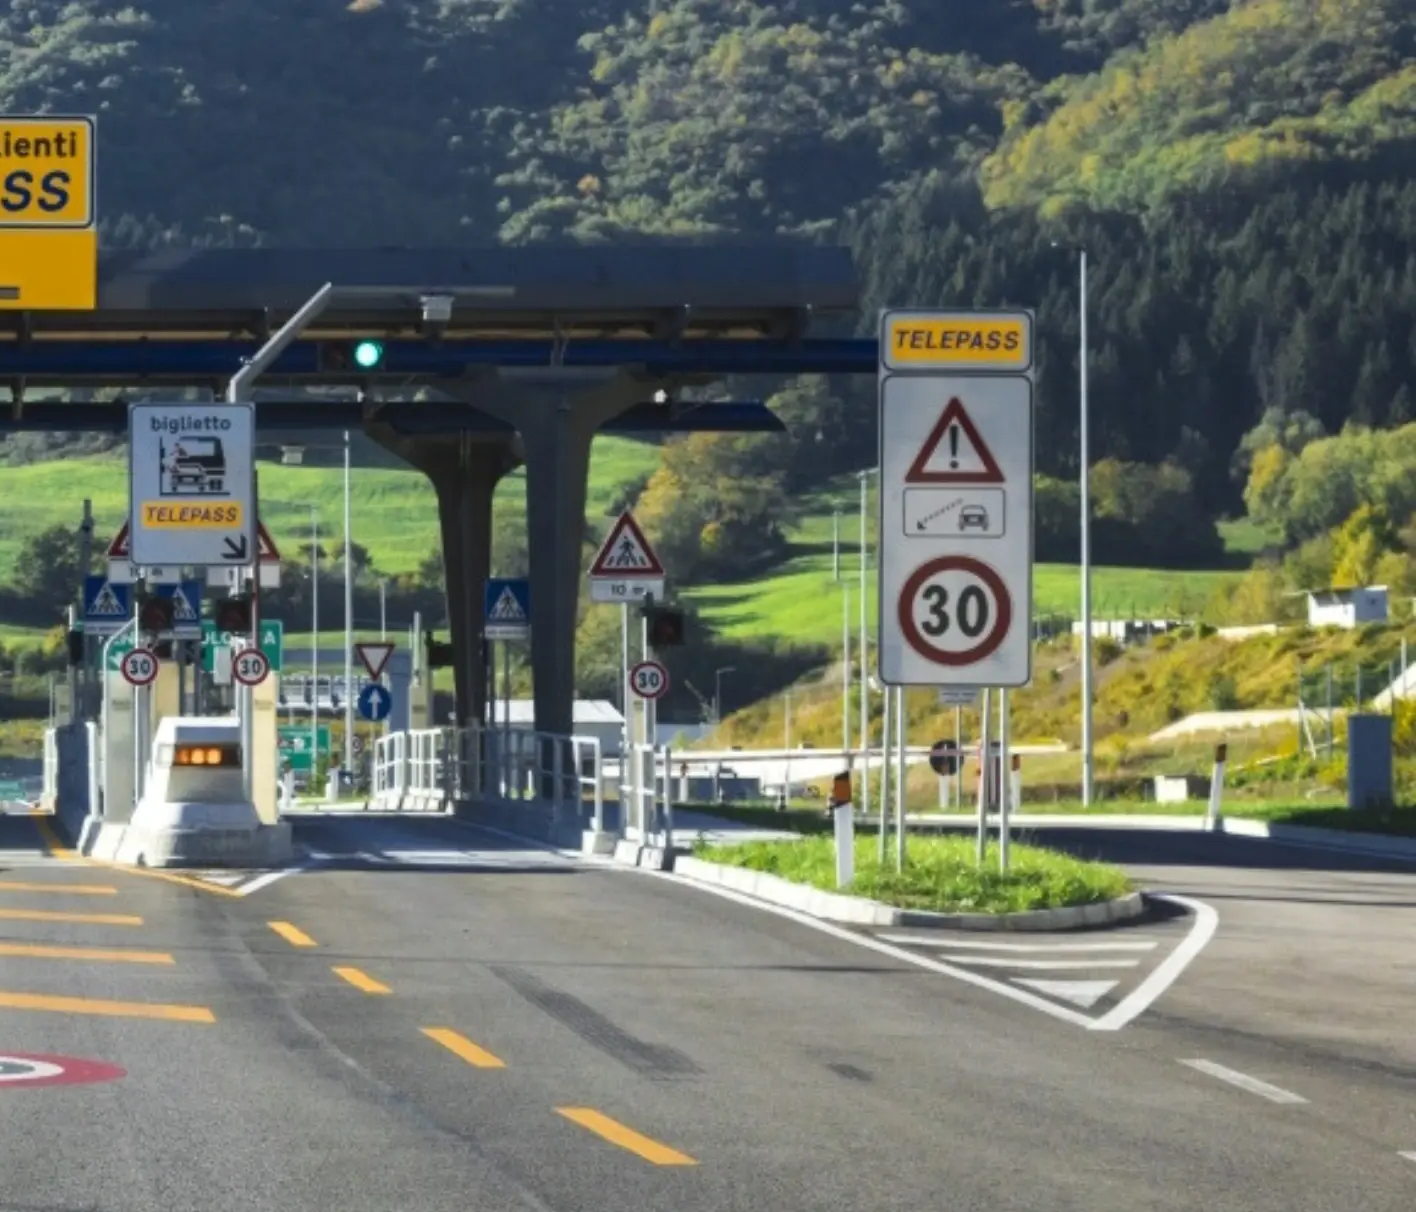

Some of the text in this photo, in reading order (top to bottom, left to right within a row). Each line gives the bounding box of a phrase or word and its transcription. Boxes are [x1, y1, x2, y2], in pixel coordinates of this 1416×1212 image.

[895, 330, 1020, 351] TELEPASS
[150, 416, 231, 434] biglietto
[146, 506, 239, 522] TELEPASS
[921, 584, 989, 638] 30
[130, 659, 151, 675] 30
[240, 659, 261, 675] 30
[638, 672, 660, 688] 30
